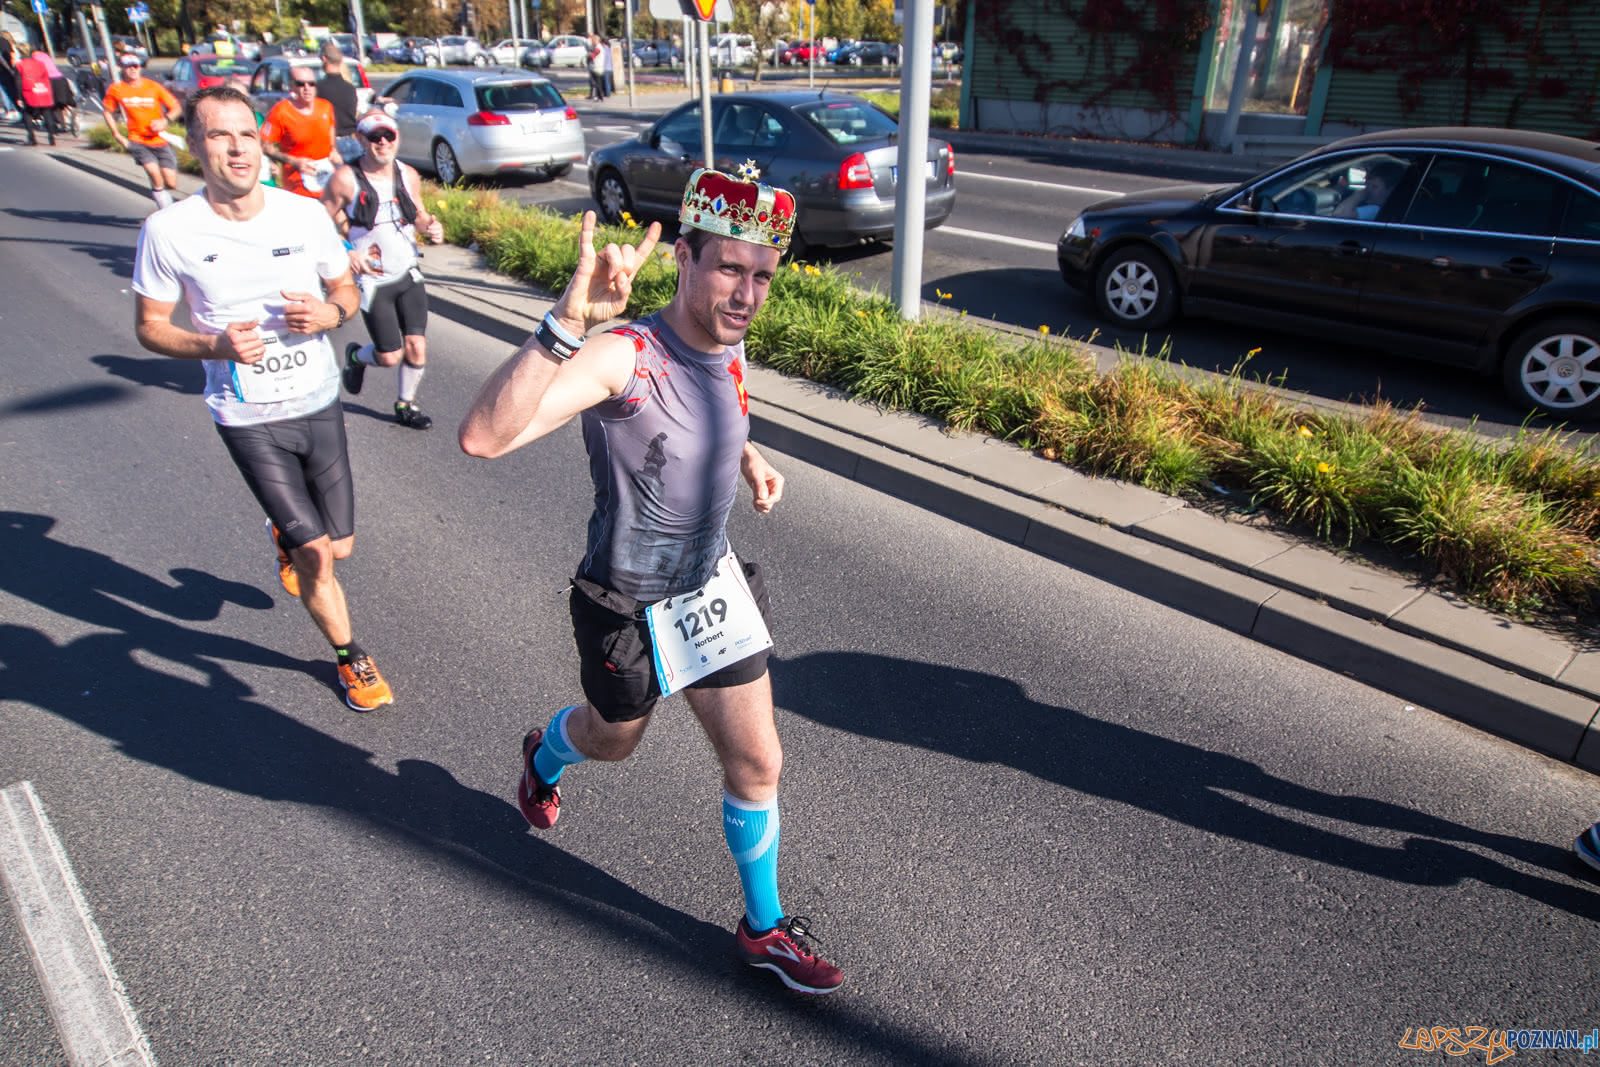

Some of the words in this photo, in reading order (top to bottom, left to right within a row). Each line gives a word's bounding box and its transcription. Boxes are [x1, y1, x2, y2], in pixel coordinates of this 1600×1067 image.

[252, 350, 307, 374] 5020
[674, 598, 727, 642] 1219
[694, 631, 724, 649] Norbert
